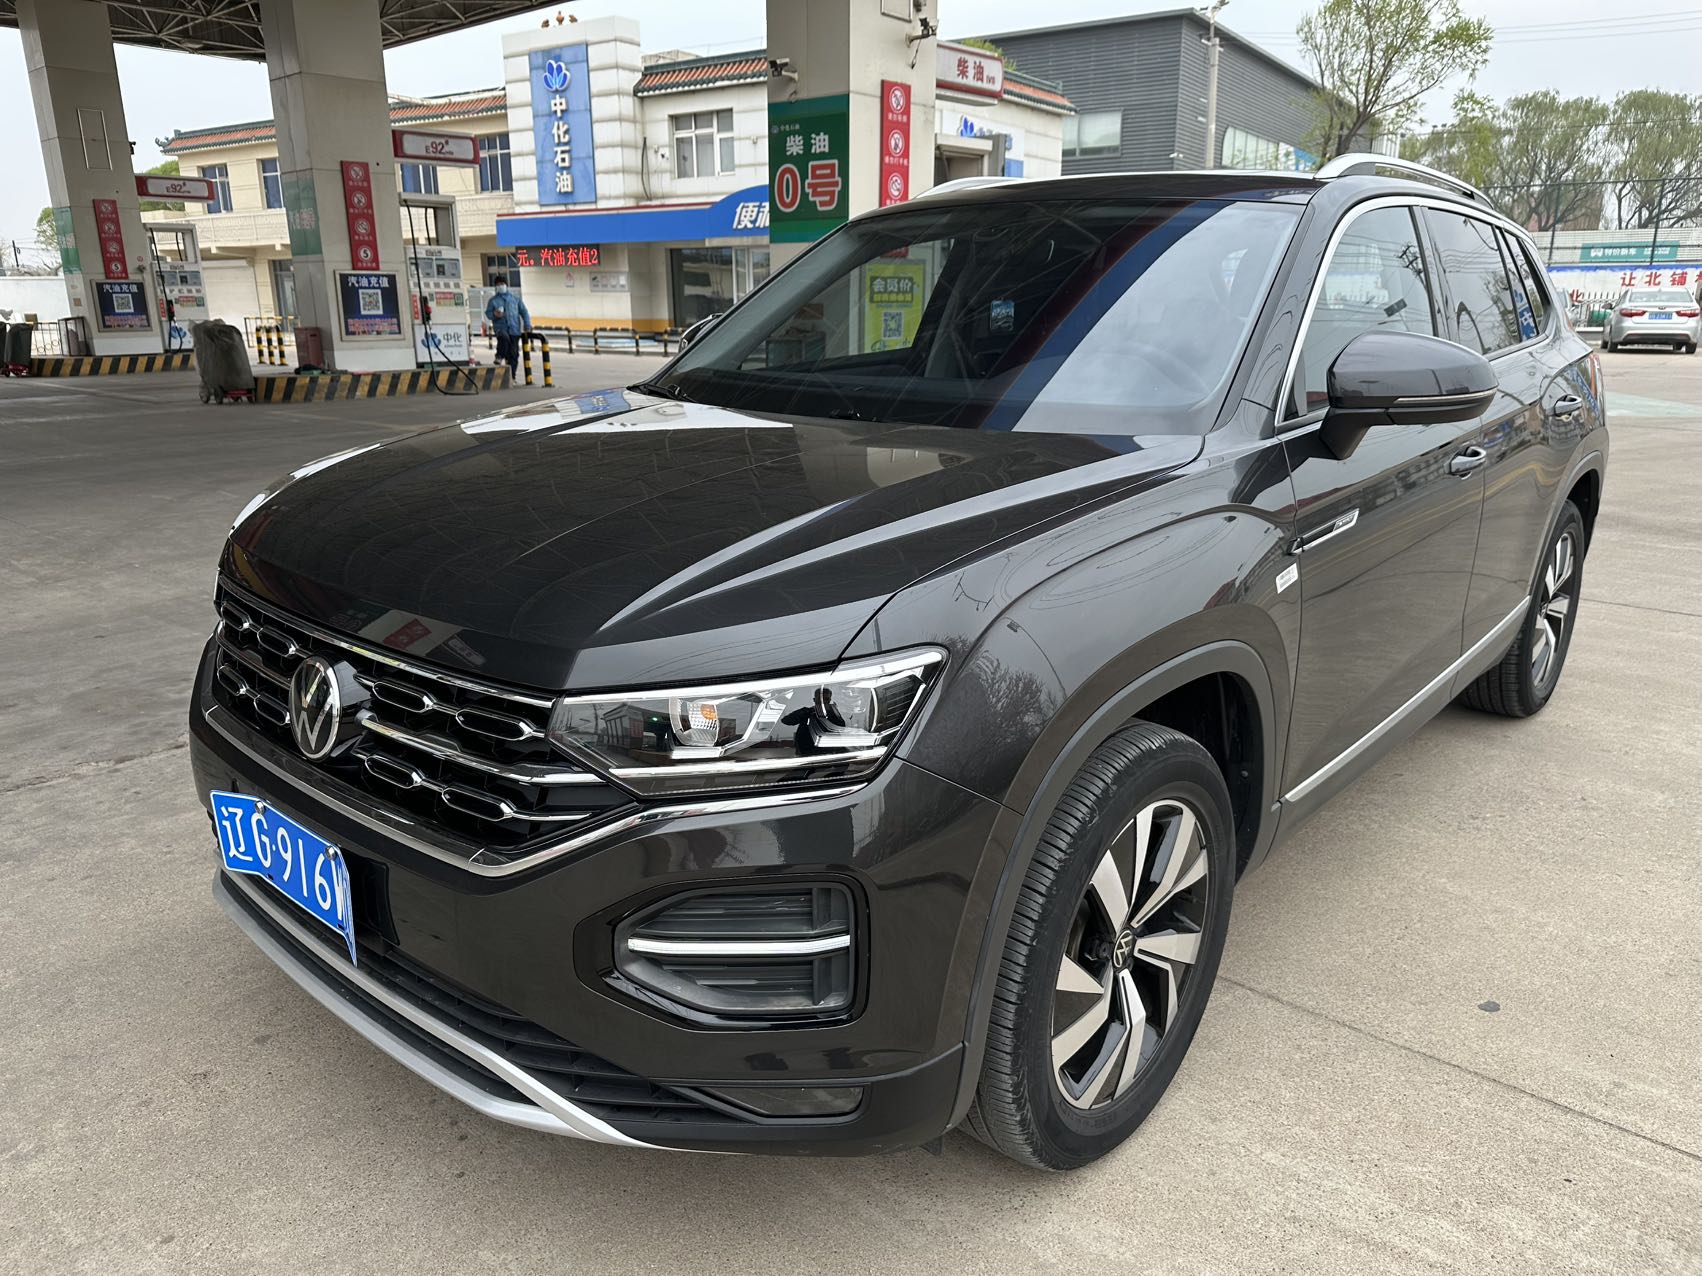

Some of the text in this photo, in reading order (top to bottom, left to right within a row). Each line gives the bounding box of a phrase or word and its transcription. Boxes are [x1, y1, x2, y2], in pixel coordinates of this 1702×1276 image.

[956, 56, 985, 82] 柴油
[550, 94, 574, 194] 中化石油
[785, 132, 829, 156] 柴油
[775, 159, 842, 212] 0号
[103, 283, 139, 293] 汽油充值
[348, 275, 390, 288] 汽油充值
[872, 278, 912, 292] 会员价
[443, 332, 463, 342] 中化
